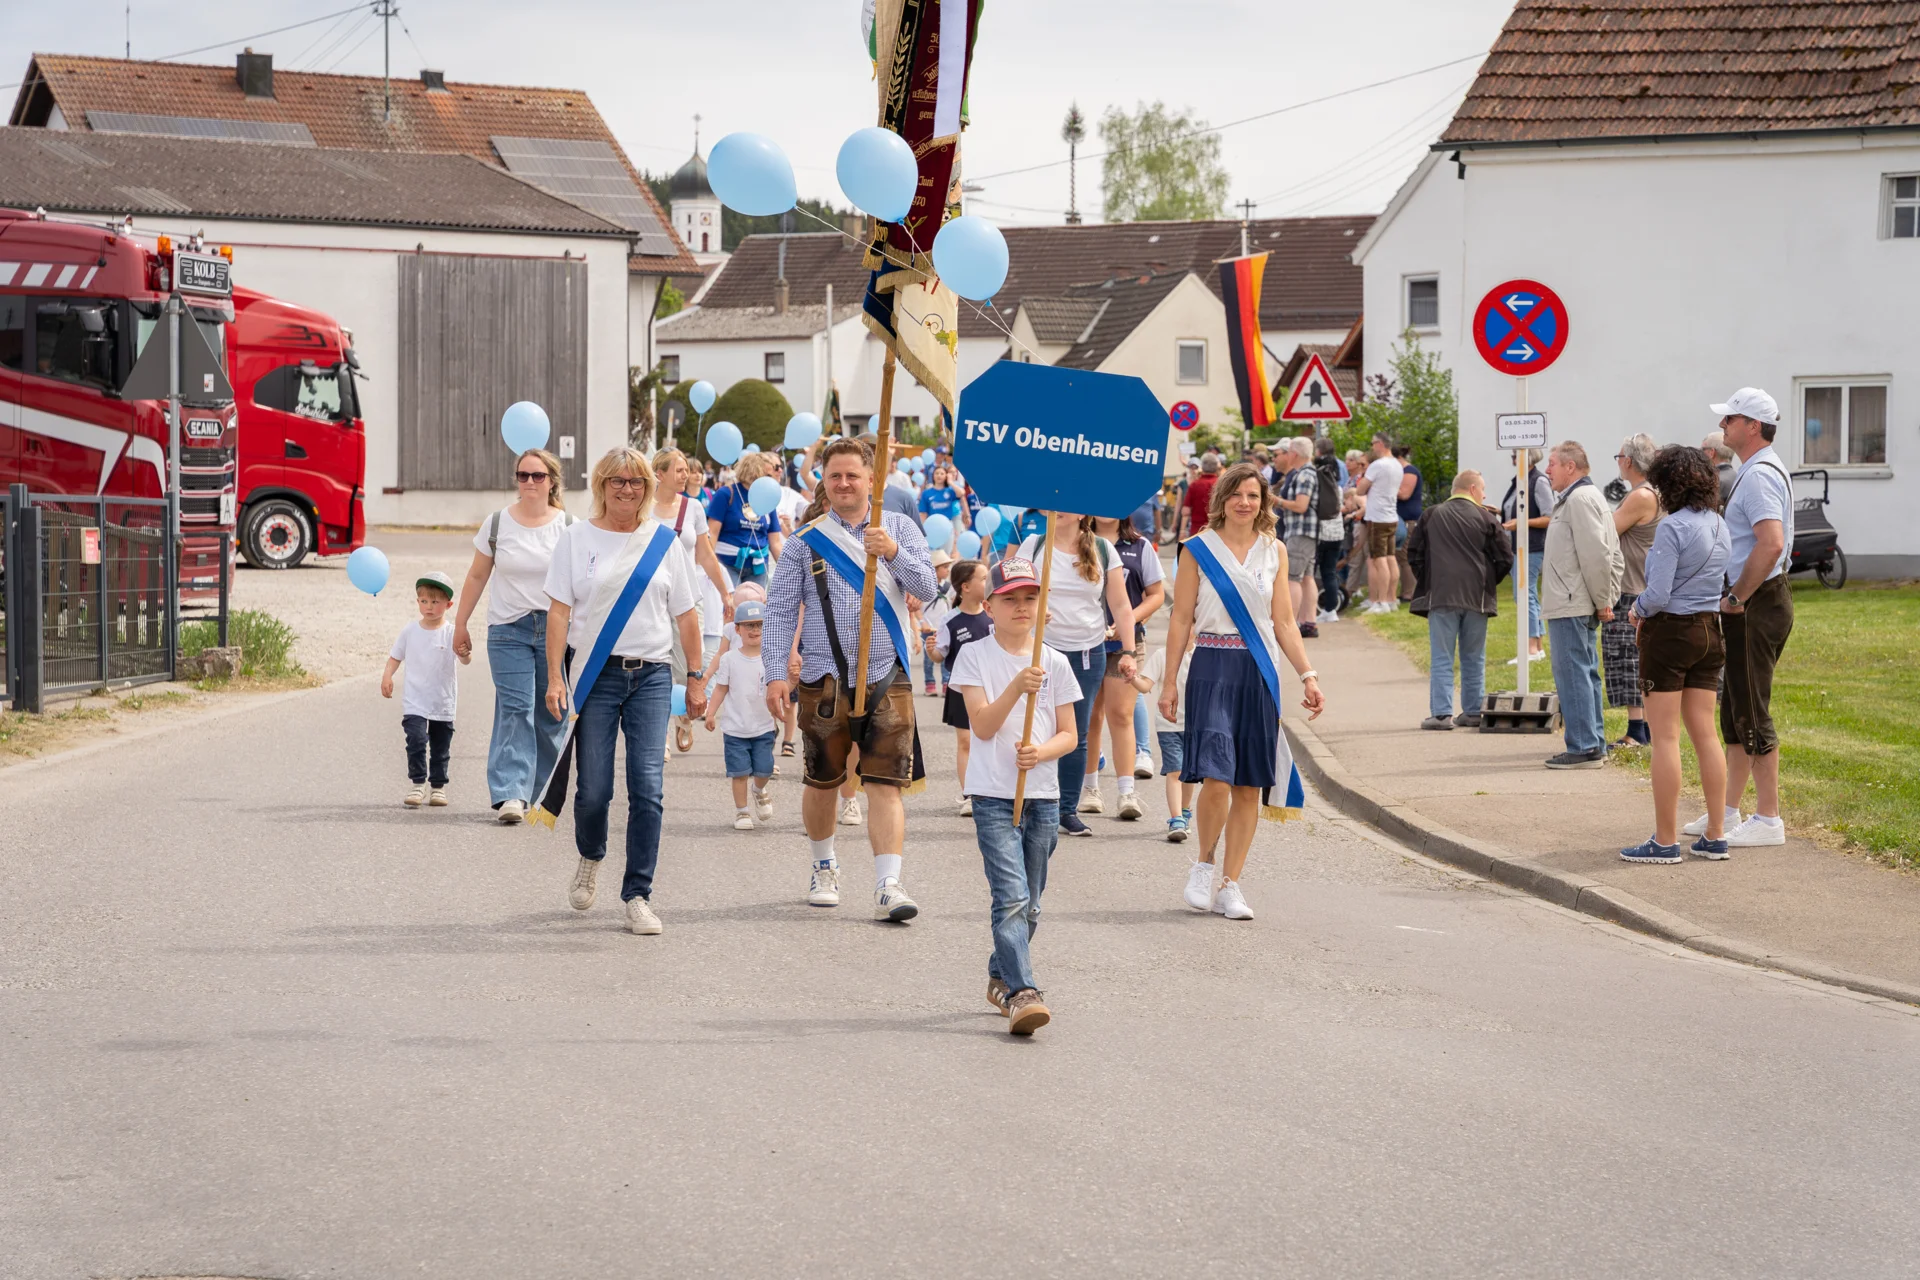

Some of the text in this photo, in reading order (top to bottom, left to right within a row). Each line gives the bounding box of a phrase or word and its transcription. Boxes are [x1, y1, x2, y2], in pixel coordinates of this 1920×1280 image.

[193, 261, 216, 279] KOLB
[190, 421, 219, 436] SCANIA
[964, 419, 1159, 465] TSV Obenhausen
